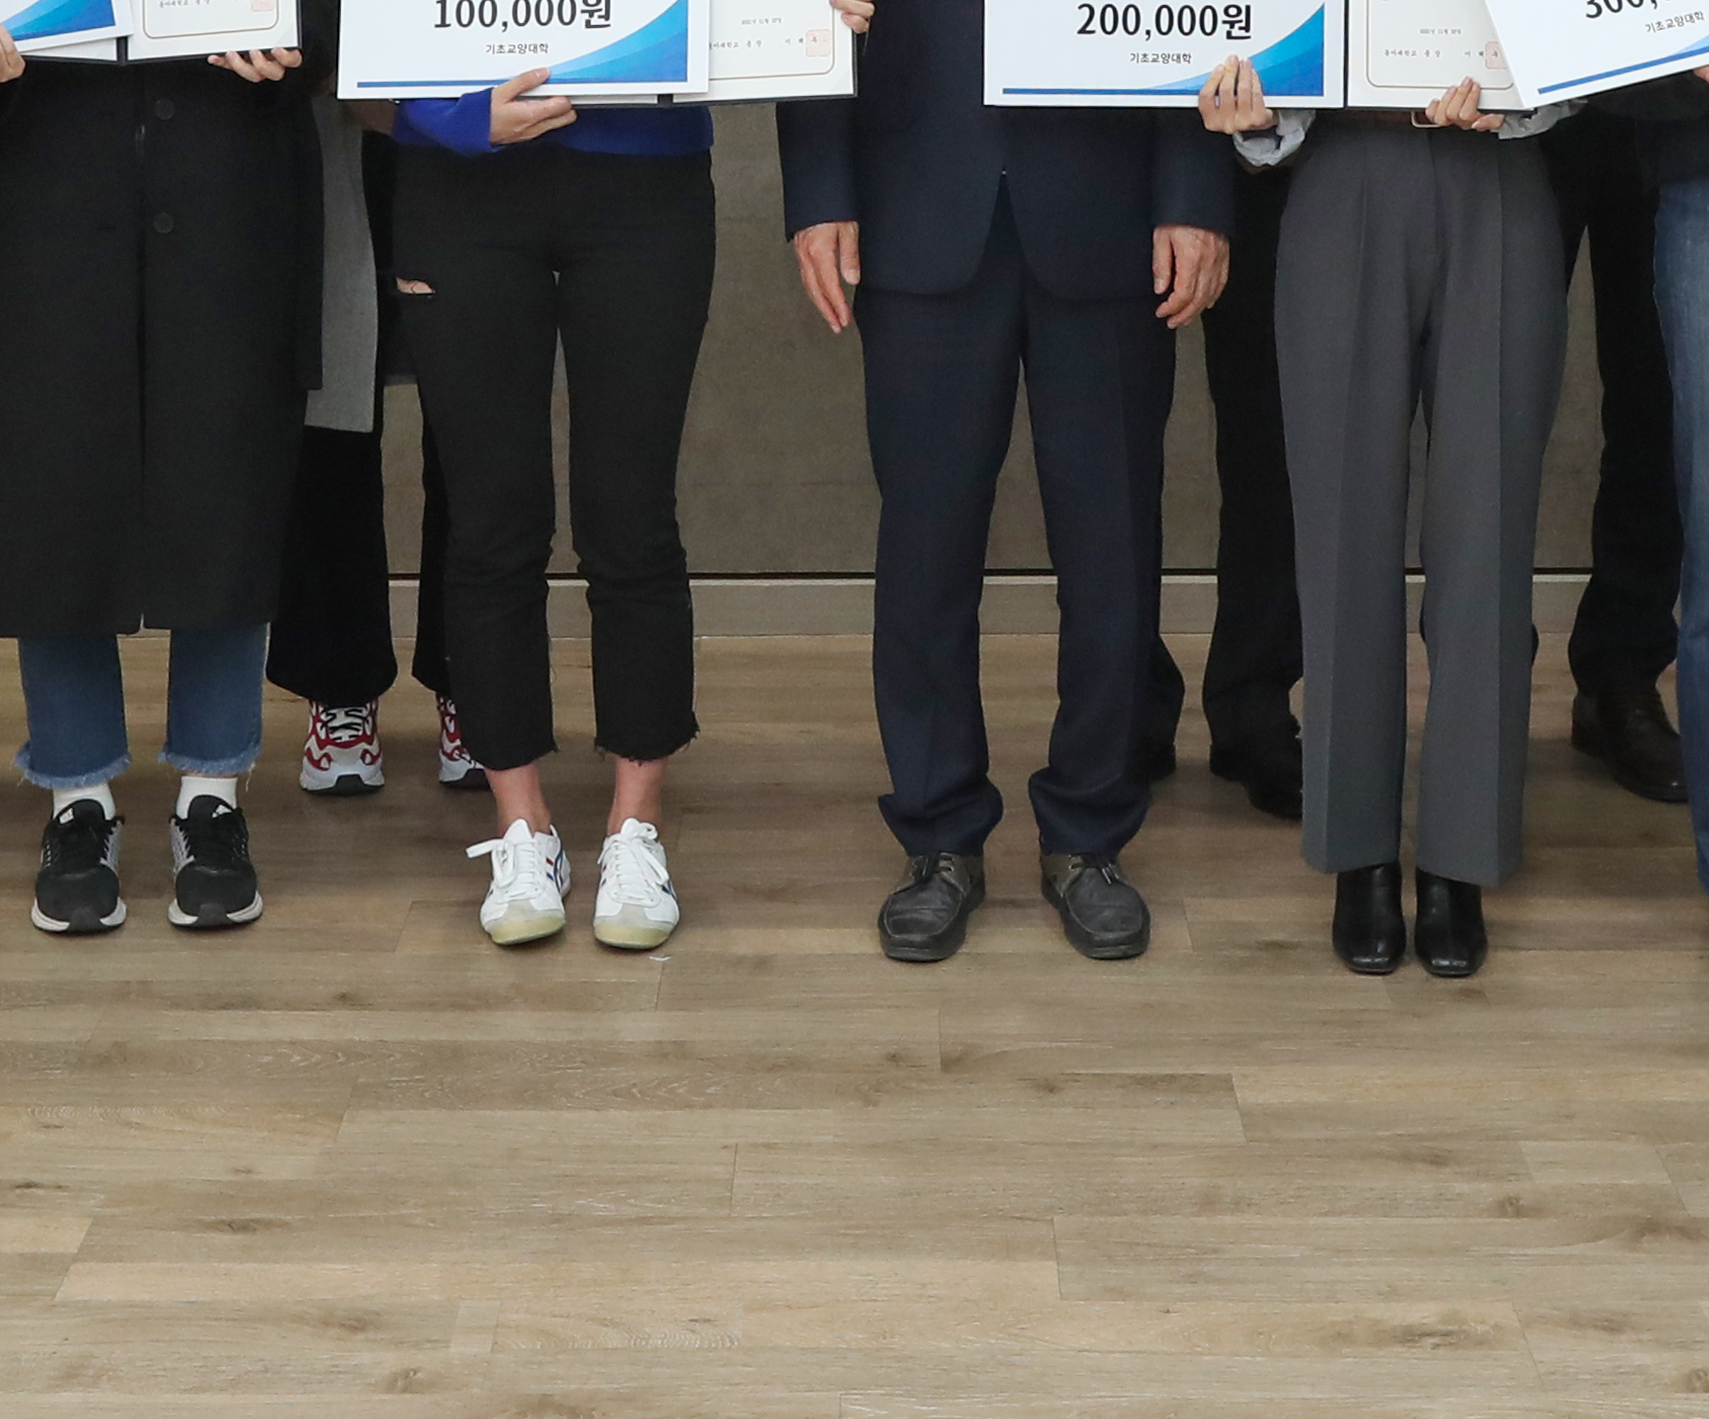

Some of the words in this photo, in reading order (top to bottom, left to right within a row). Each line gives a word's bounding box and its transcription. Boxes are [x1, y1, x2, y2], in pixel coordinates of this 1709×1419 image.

[1076, 2, 1253, 42] 200,000원
[1644, 10, 1705, 33] 기초교양대학
[485, 43, 549, 55] 기초교양대학
[1129, 52, 1192, 65] 기초교양대학
